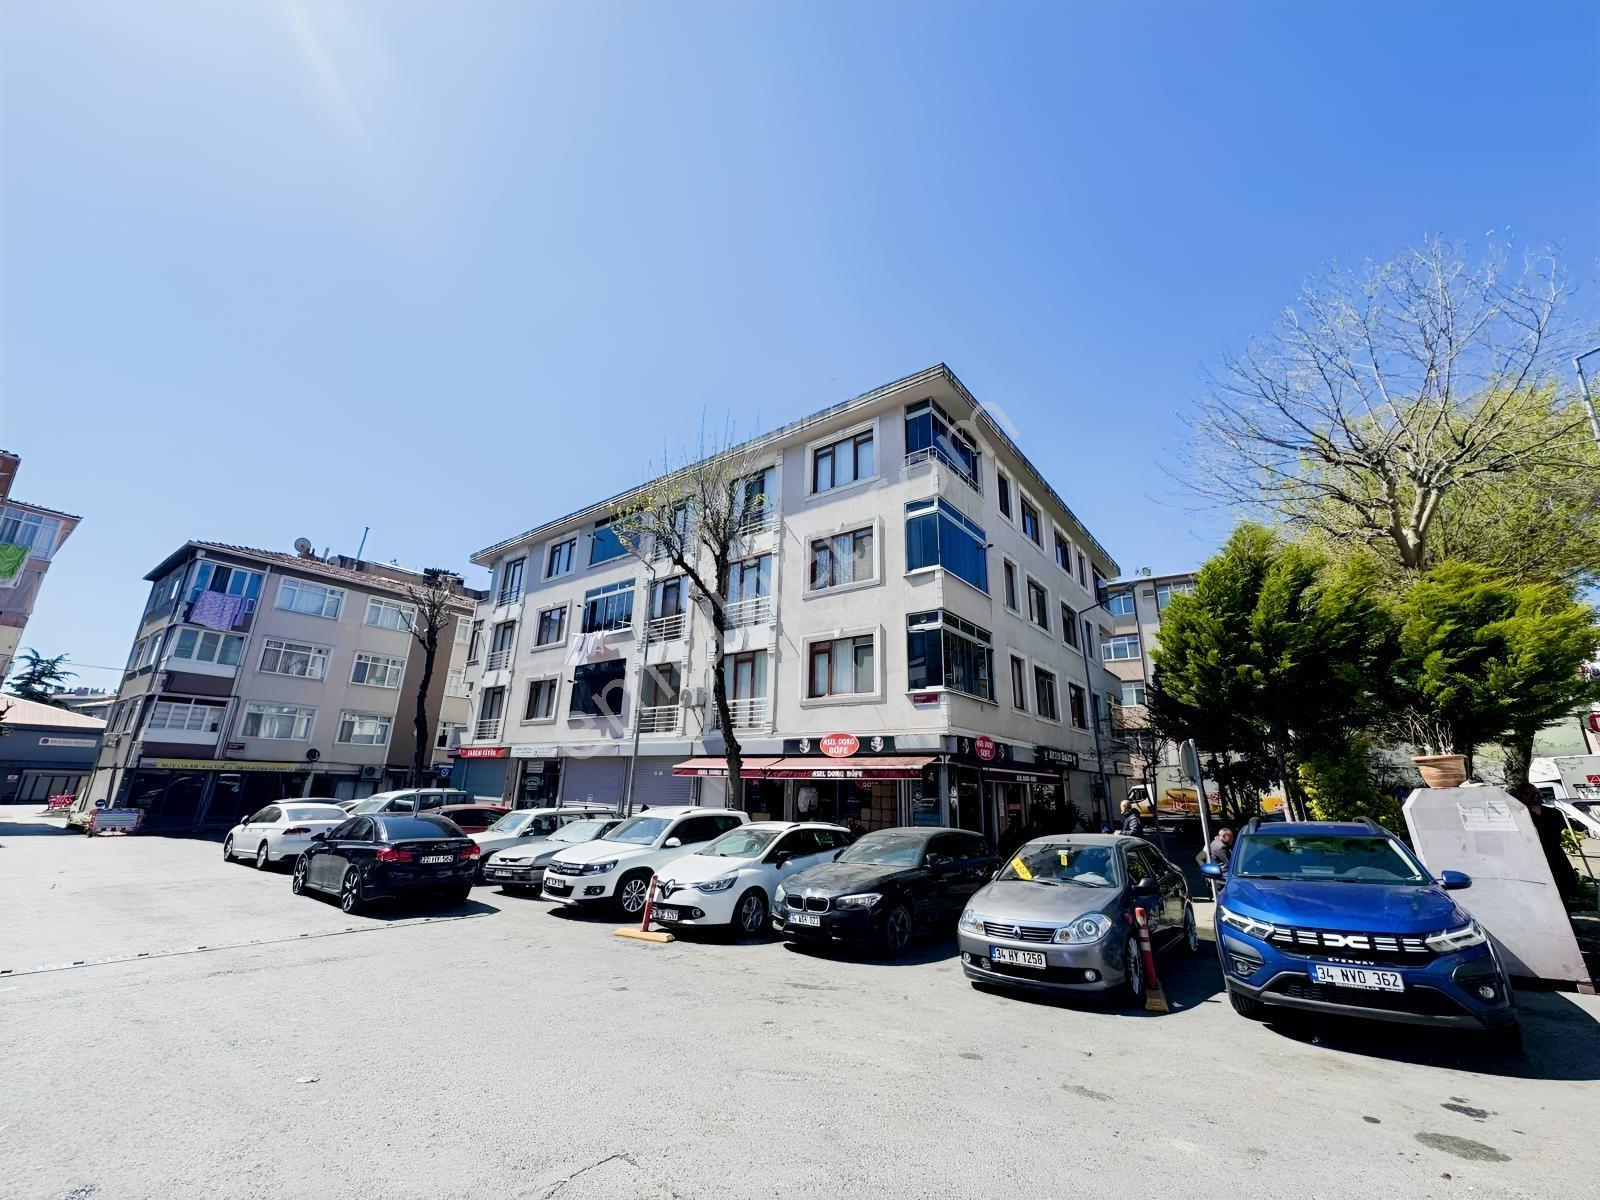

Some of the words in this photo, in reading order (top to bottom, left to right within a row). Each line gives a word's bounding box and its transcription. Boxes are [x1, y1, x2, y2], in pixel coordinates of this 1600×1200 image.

[811, 770, 826, 778] ASEL
[996, 948, 1006, 959] 34
[1008, 950, 1018, 961] HY
[1317, 967, 1334, 981] 34
[1373, 972, 1400, 987] 362
